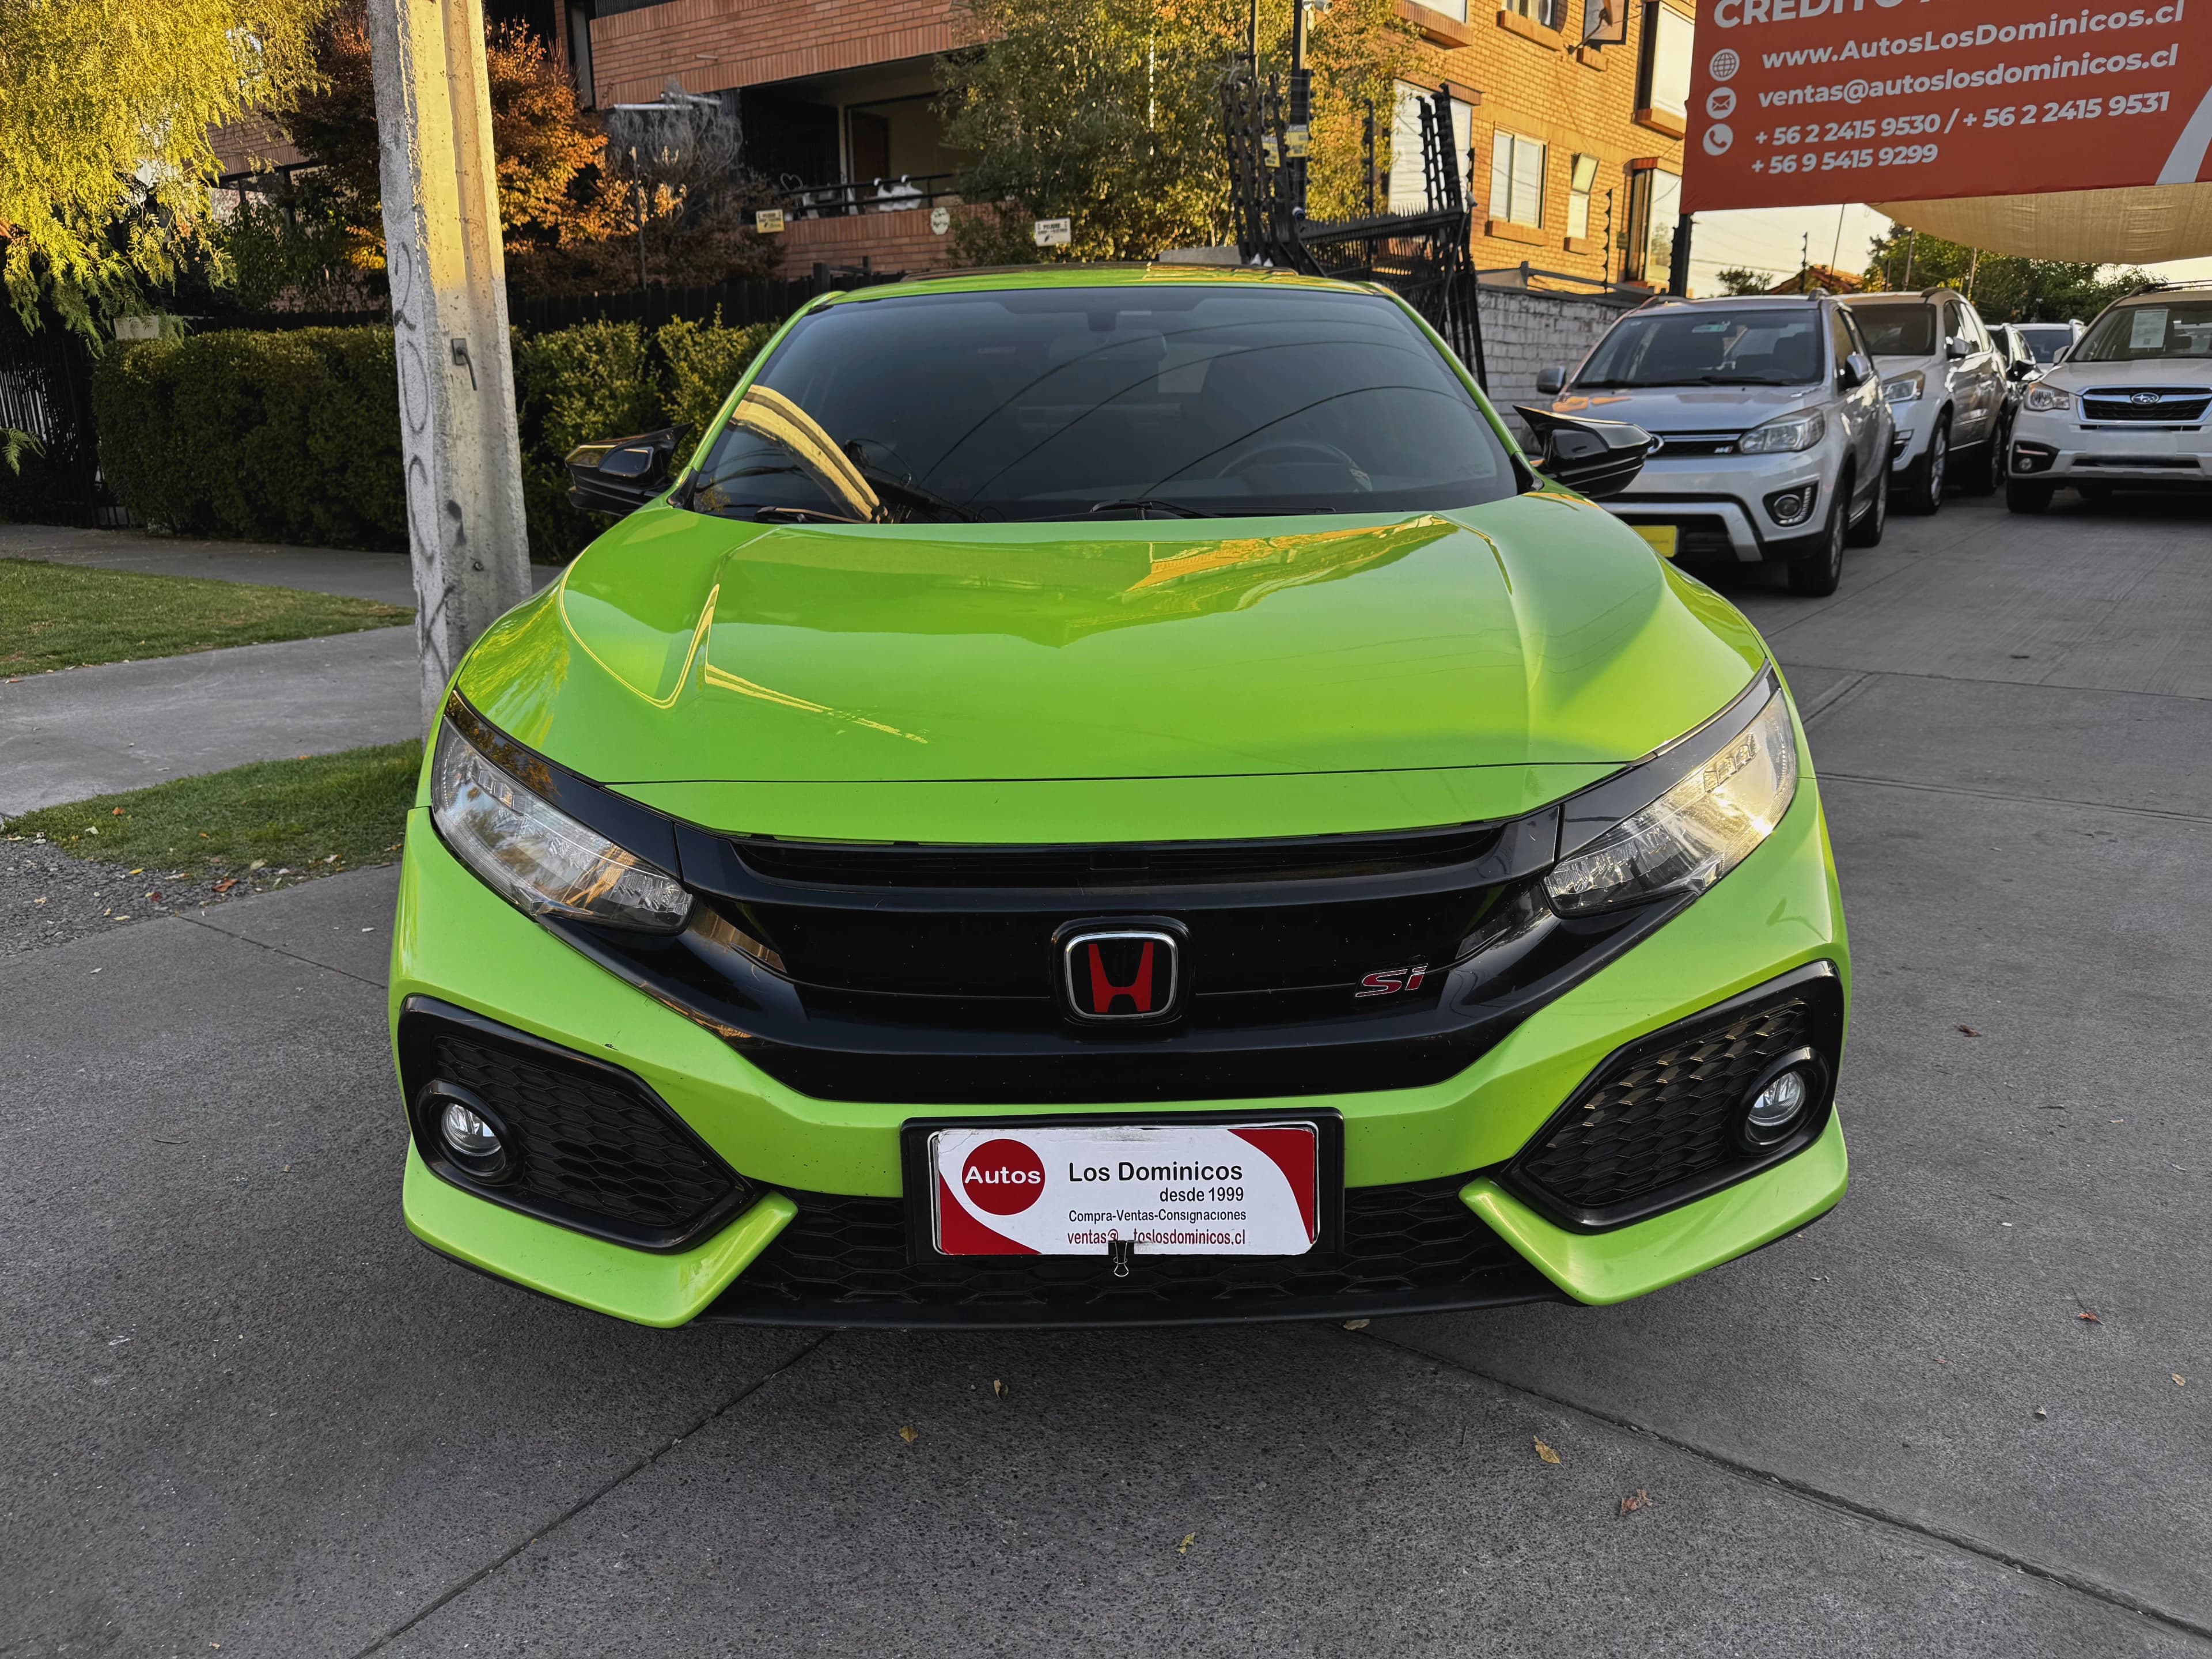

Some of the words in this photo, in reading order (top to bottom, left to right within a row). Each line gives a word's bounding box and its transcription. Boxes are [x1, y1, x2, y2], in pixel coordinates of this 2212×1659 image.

[1762, 0, 2184, 69] www.AutosLosDominicos.cl
[1759, 43, 2179, 107] ventas@autoslosdominicos.cl
[1755, 131, 1768, 144] +
[1772, 126, 1801, 146] 56
[1805, 124, 1820, 143] 2
[1823, 119, 1876, 141] 2415
[1881, 114, 1941, 137] 9530
[1963, 113, 1978, 127] +
[1982, 106, 2016, 128] 56
[2020, 104, 2037, 125] 2
[2041, 97, 2103, 123] 2415
[2108, 91, 2170, 116] 9531
[1752, 160, 1764, 172] +
[1768, 154, 1797, 174] 56
[1801, 153, 1817, 172] 9
[1821, 149, 1873, 171] 5415
[1878, 143, 1938, 166] 9299
[1354, 963, 1429, 998] Si
[964, 1166, 1041, 1184] Autos
[1069, 1162, 1110, 1182] Los
[1119, 1161, 1243, 1181] Dominicos
[1160, 1187, 1205, 1202] desde
[1208, 1187, 1244, 1202] 1999
[1069, 1209, 1247, 1225] Compra-Ventas-Consignaciones
[1067, 1228, 1245, 1245] ventas@toslosdominicos.cl
